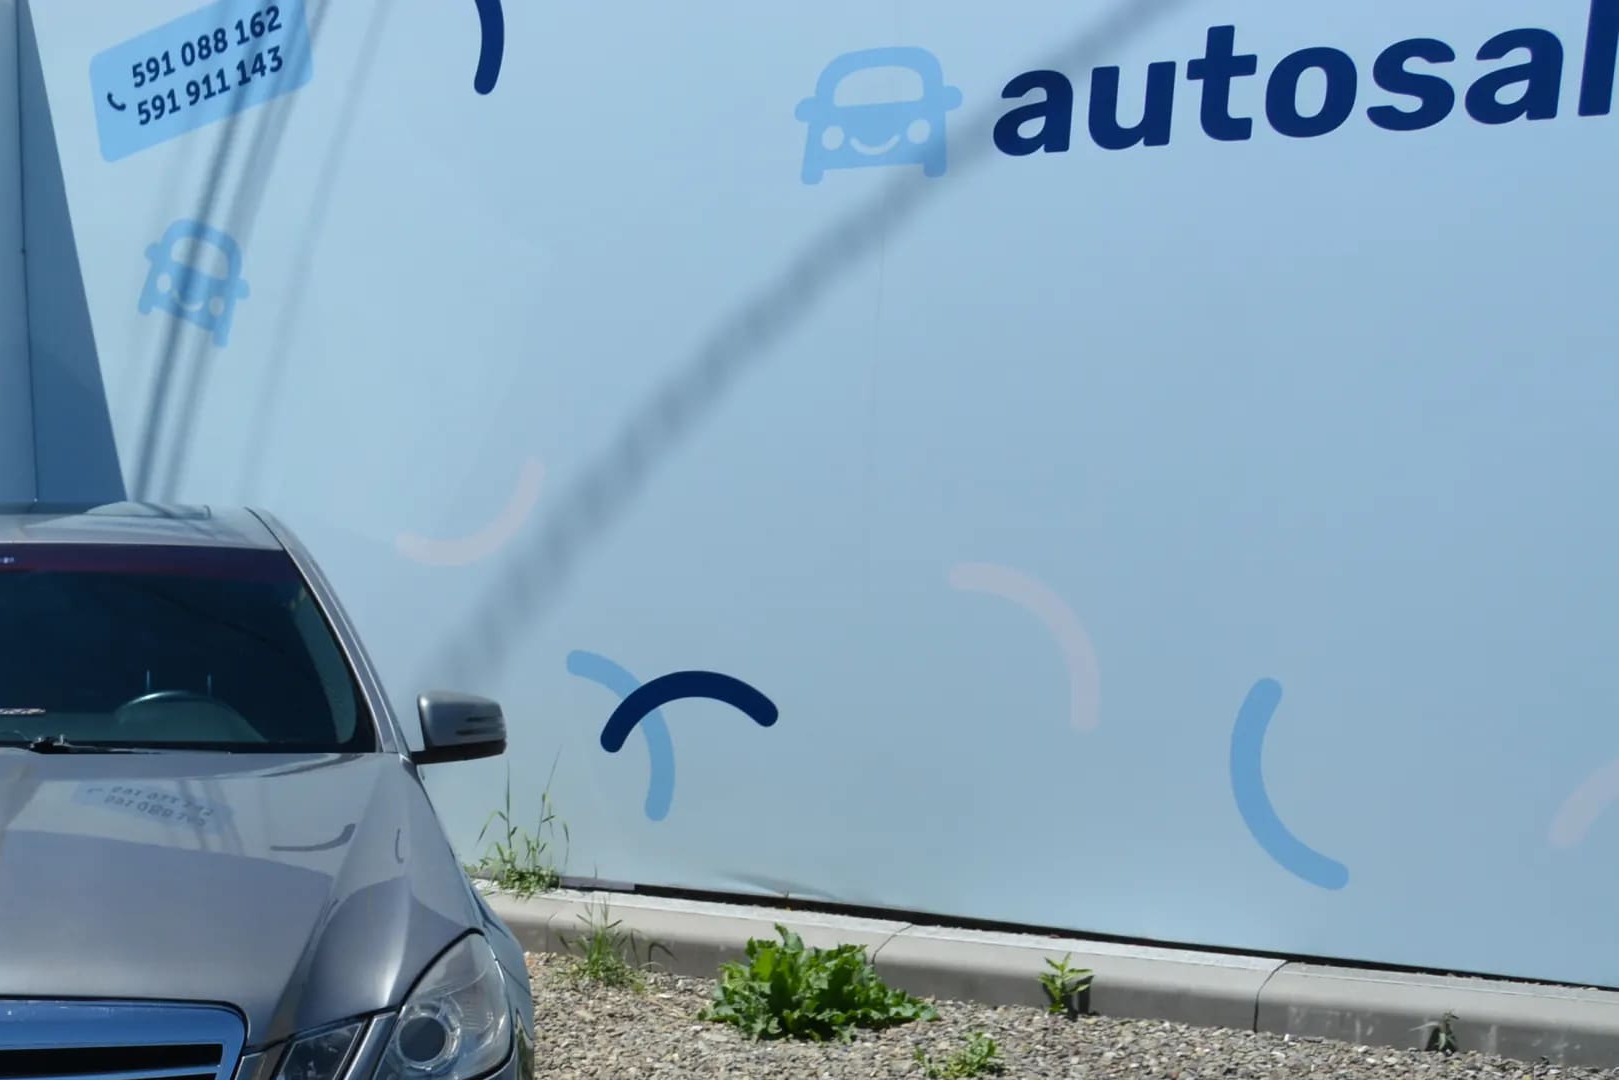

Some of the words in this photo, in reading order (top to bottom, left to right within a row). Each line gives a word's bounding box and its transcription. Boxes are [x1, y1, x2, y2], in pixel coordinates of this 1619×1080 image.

[131, 51, 176, 88] 591
[180, 28, 228, 67] 088
[234, 5, 282, 46] 162
[136, 89, 182, 126] 591
[185, 69, 231, 106] 911
[235, 46, 283, 87] 143
